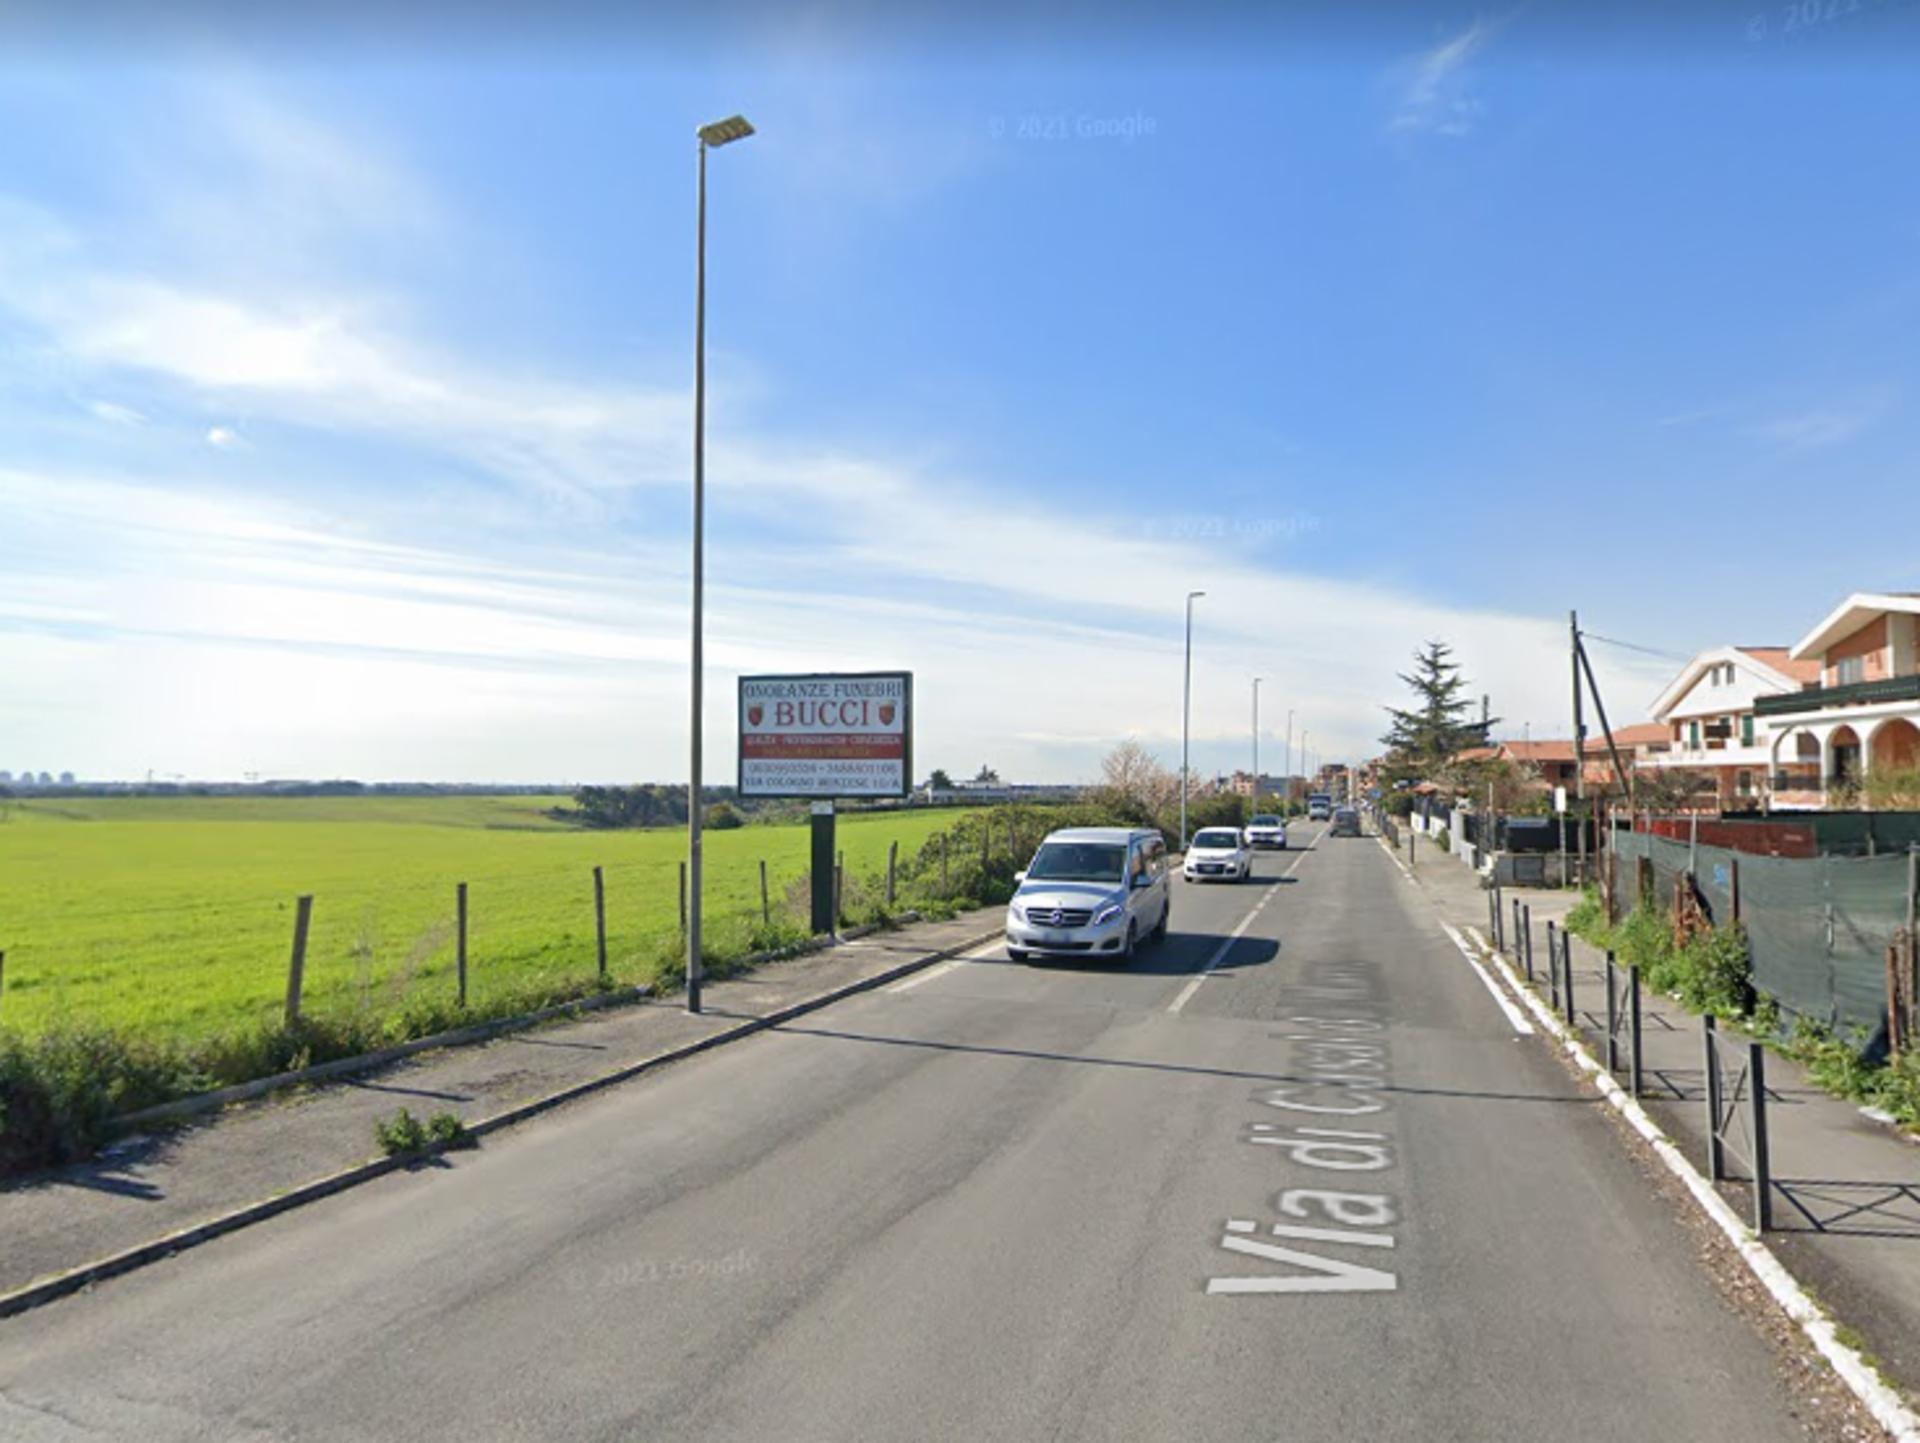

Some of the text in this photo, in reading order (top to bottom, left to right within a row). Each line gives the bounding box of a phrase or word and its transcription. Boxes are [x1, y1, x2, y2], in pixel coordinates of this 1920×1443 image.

[745, 681, 902, 698] ONORANZE FUNEBRI
[775, 699, 870, 727] BUCCI
